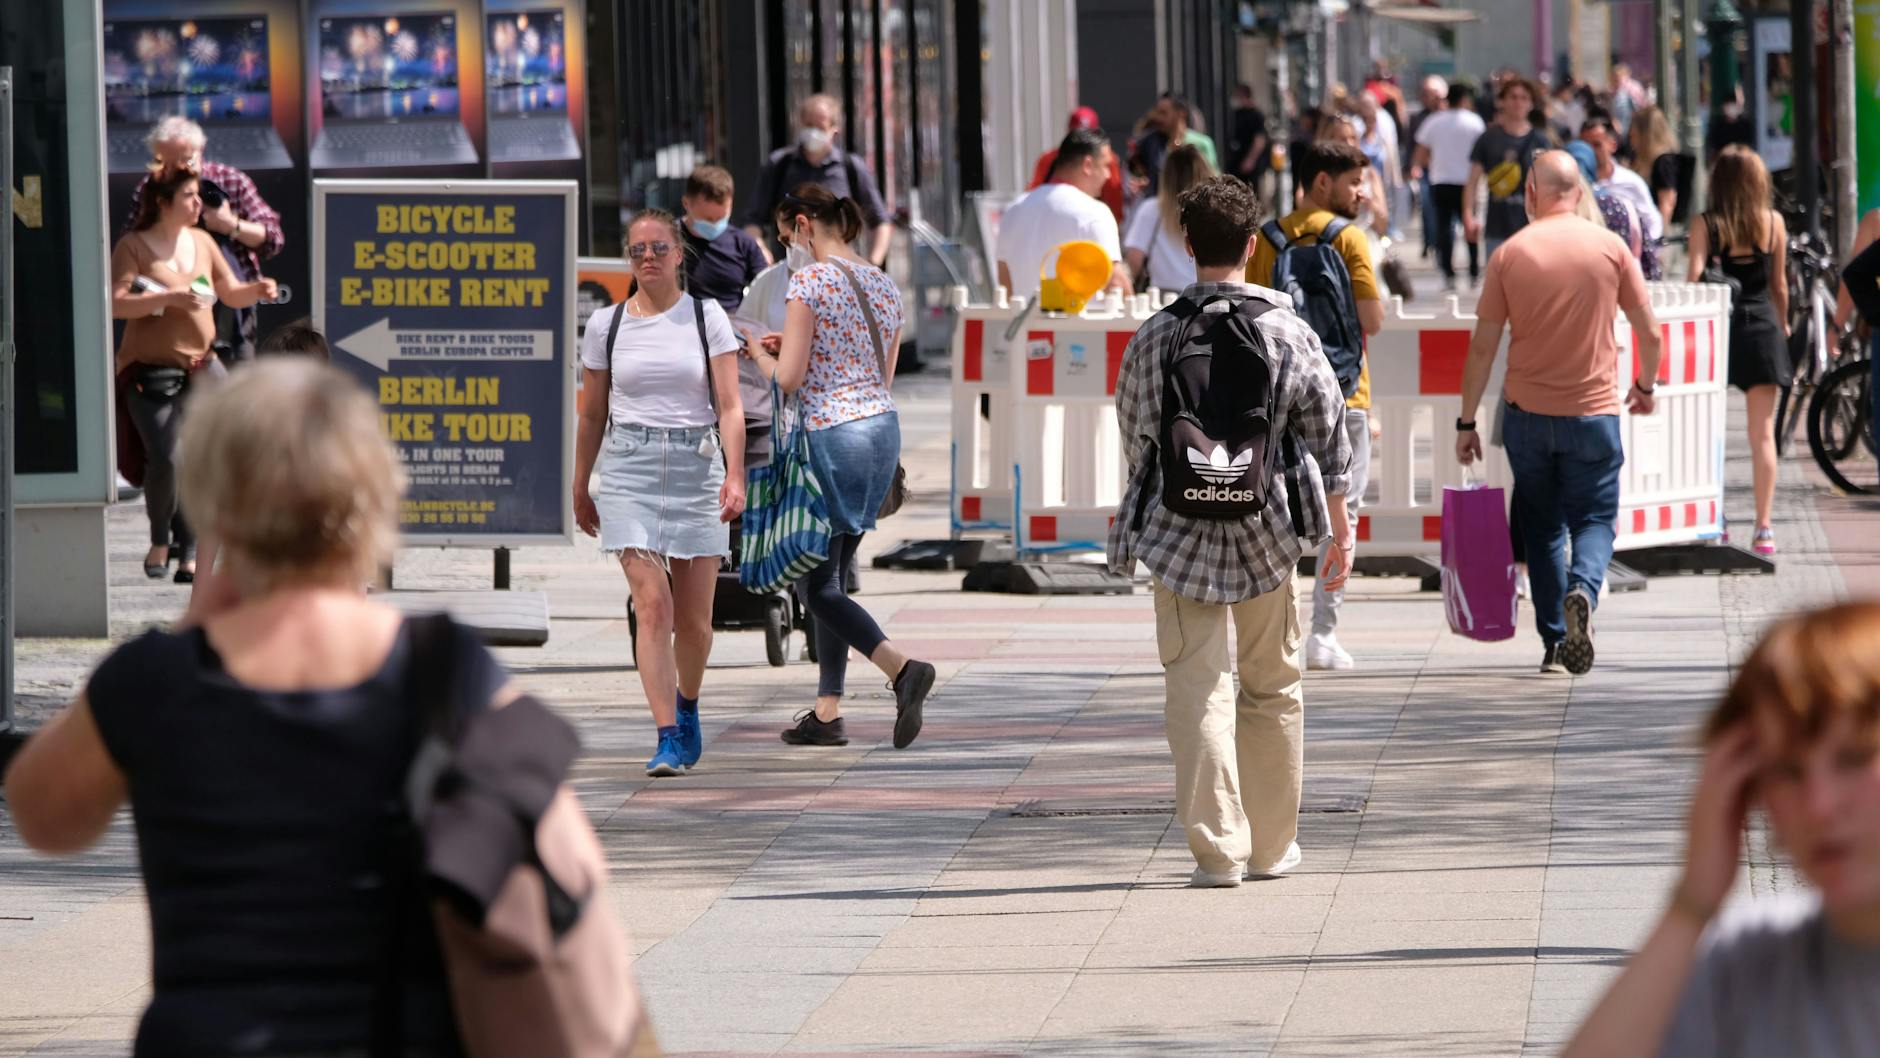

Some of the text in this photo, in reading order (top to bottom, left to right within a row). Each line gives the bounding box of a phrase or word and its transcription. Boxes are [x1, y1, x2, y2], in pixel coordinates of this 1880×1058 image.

[376, 205, 516, 234] BICYCLE
[354, 241, 537, 271] E-SCOOTER
[340, 277, 451, 307] E-BIKE
[459, 278, 550, 308] RENT
[395, 334, 423, 344] BIKE
[425, 334, 456, 344] RENT
[469, 334, 496, 345] BIKE
[498, 334, 535, 345] TOURS
[400, 346, 534, 357] BERLIN EUROPA CENTER
[378, 376, 500, 406] BERLIN
[379, 412, 532, 442] IKE TOUR
[413, 448, 429, 461] IN
[432, 448, 462, 462] ONE
[465, 448, 505, 462] TOUR
[449, 464, 460, 475] IN
[462, 464, 500, 475] BERLIN
[1183, 485, 1255, 502] adidas
